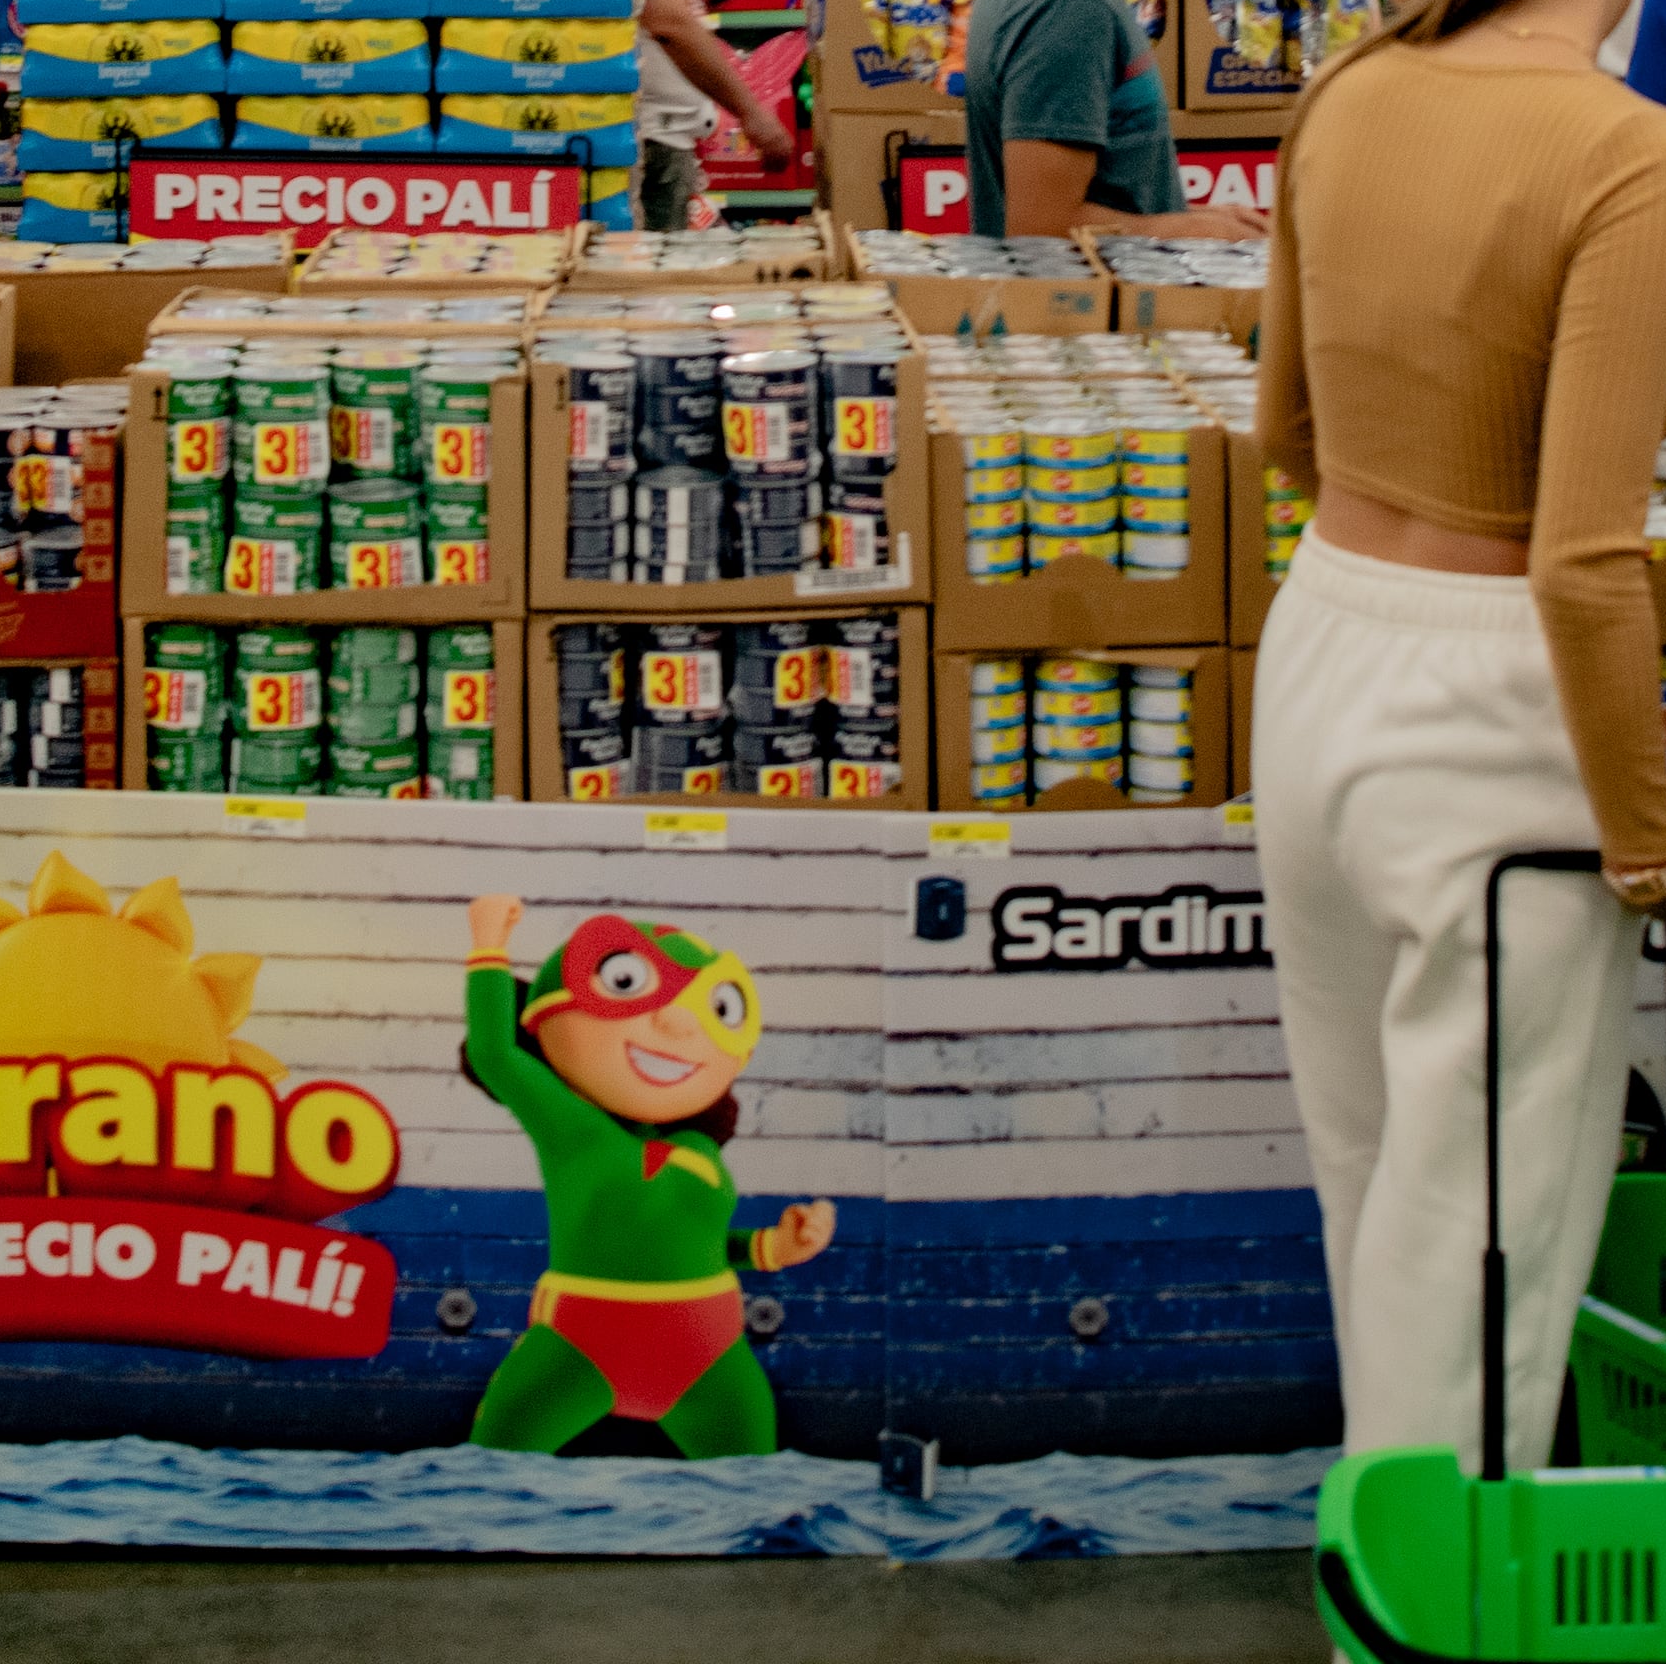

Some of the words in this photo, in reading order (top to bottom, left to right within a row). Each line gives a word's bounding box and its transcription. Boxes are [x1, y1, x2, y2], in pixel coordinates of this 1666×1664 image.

[154, 173, 397, 226] PRECIO
[405, 170, 556, 229] PALÍ
[185, 426, 208, 473] 3
[729, 409, 746, 455] 3
[843, 404, 867, 450] 3
[264, 429, 289, 475] 3
[440, 429, 463, 475] 3
[234, 542, 253, 589] 3
[357, 547, 381, 589] 3
[454, 676, 479, 722] 3
[653, 658, 677, 704] 3
[785, 656, 805, 700] 3
[257, 679, 282, 724] 3
[1002, 894, 1275, 962] Sardim
[177, 1232, 365, 1317] PALÍ!
